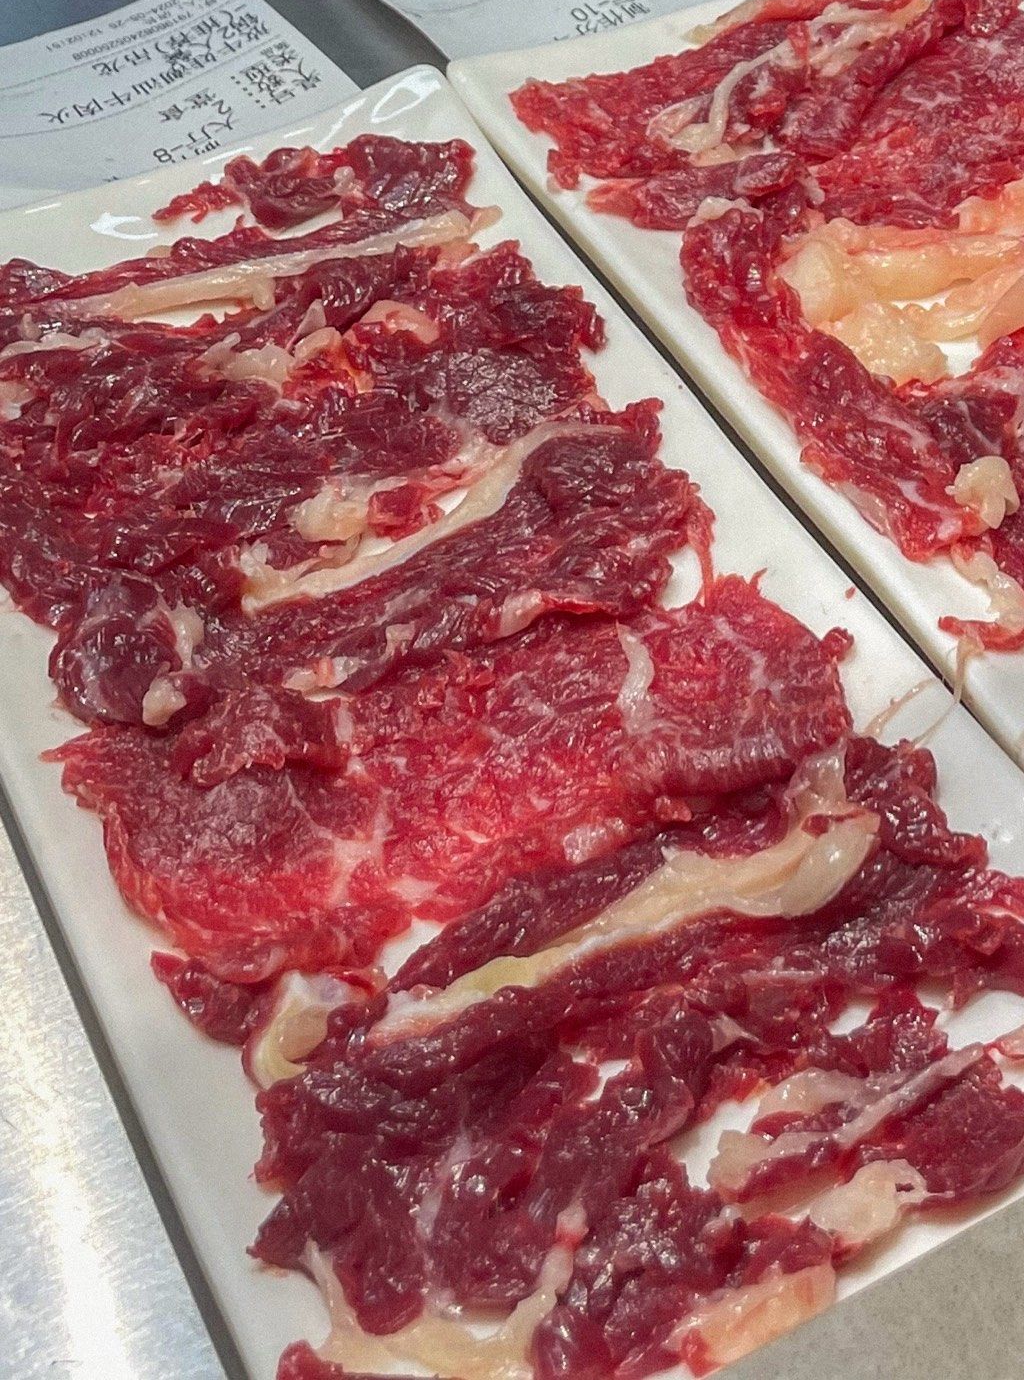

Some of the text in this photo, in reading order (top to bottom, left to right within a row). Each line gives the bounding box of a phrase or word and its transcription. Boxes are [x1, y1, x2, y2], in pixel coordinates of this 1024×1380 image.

[552, 1, 651, 42] 制作分
[209, 99, 235, 115] 2
